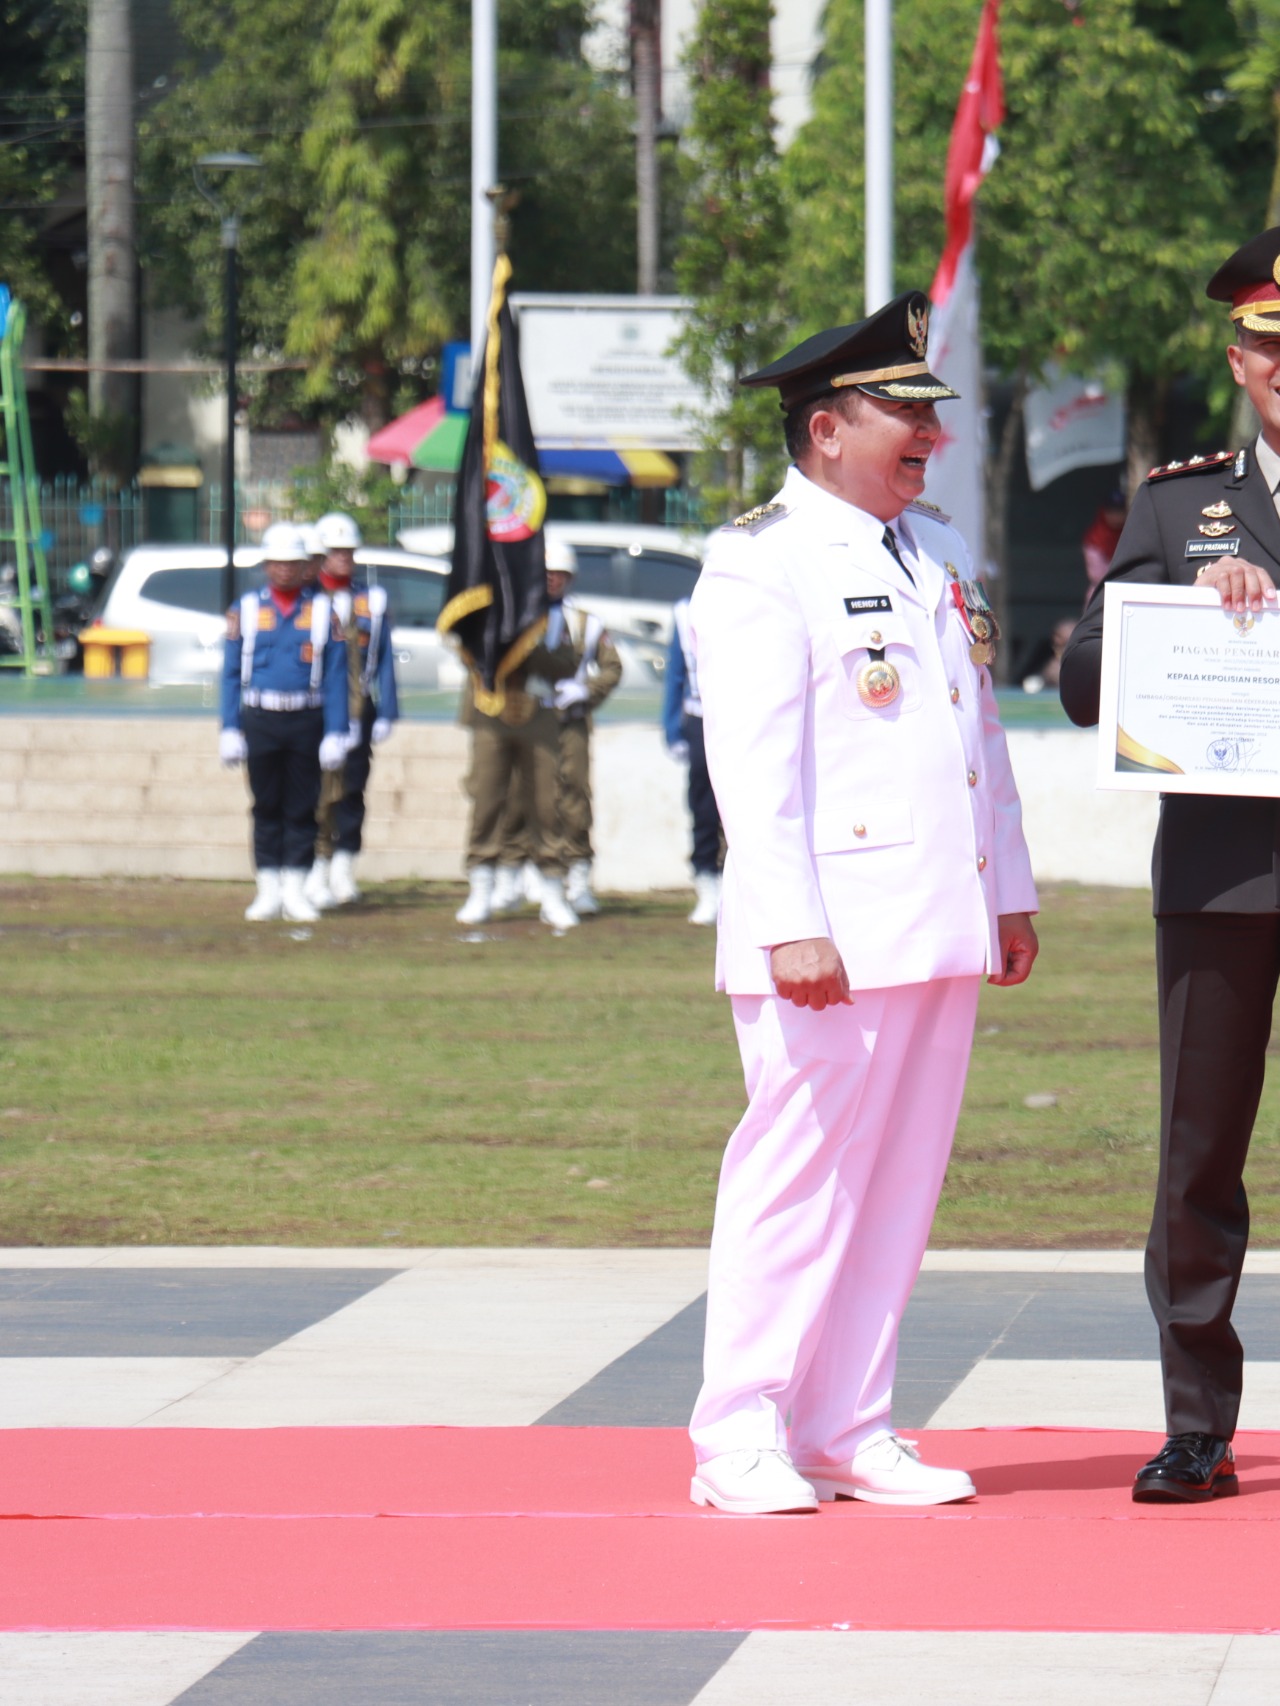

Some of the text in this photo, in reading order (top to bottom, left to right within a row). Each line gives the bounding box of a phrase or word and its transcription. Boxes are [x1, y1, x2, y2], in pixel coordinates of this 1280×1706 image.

[1188, 544, 1204, 552] BAYU
[1204, 543, 1229, 552] PRATAMA
[851, 598, 888, 608] HENDY S
[1173, 644, 1219, 655] PIAGAM
[1167, 672, 1200, 681] KEPALA
[1201, 674, 1251, 683] KEPOLISIAN
[1252, 676, 1280, 684] RESOR
